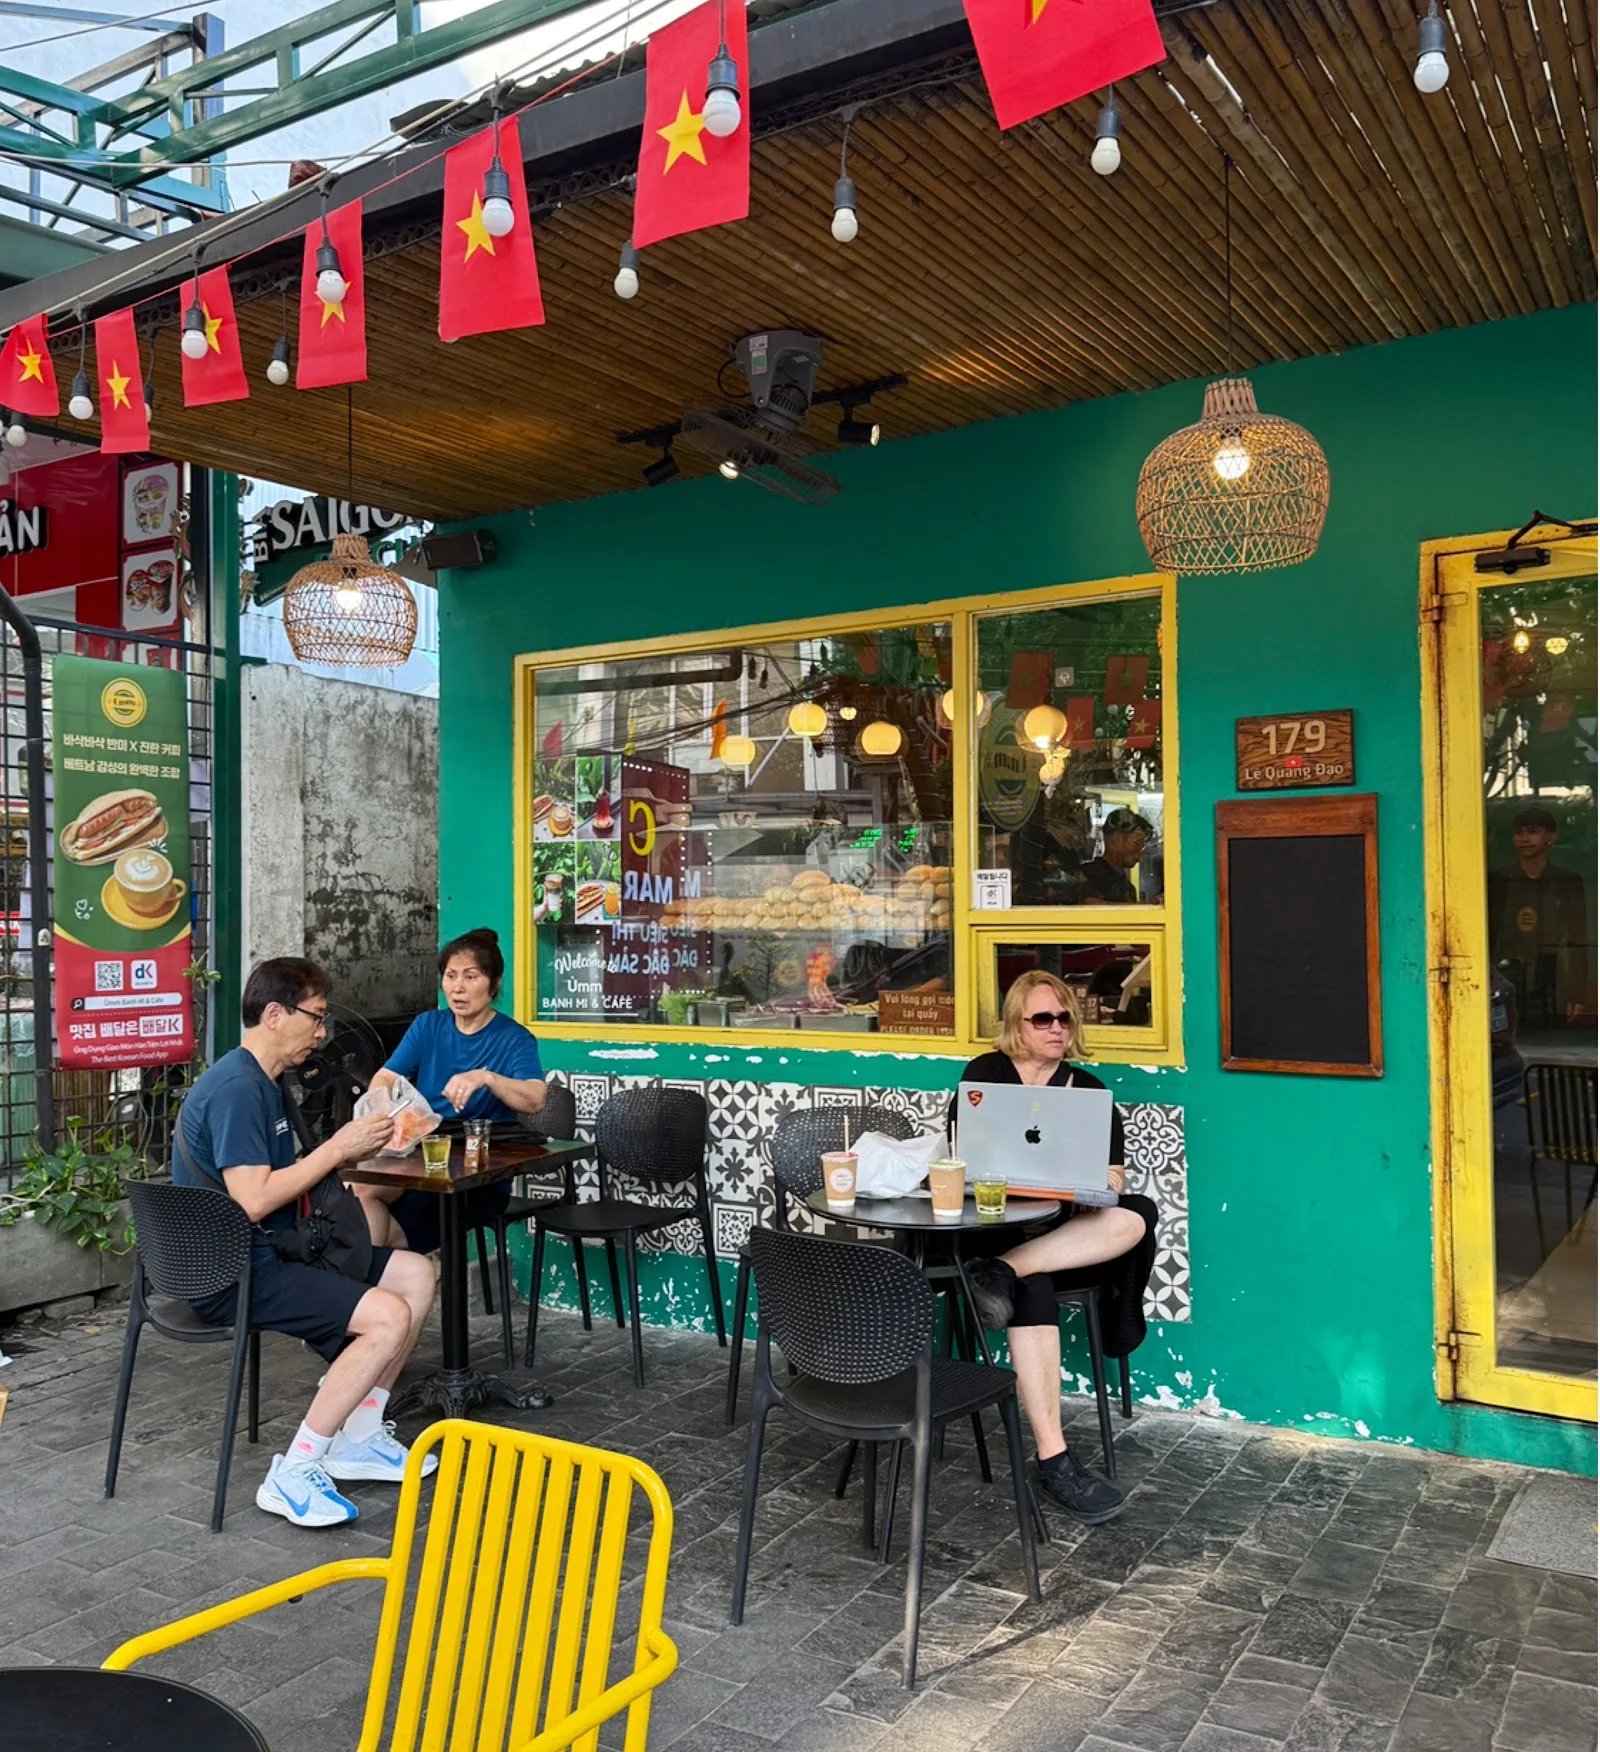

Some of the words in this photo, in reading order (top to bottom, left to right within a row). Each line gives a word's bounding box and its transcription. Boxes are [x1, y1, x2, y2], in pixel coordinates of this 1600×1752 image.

[271, 497, 414, 551] SAIGO
[63, 733, 105, 749] 바삭바삭
[107, 738, 128, 751] 반미
[129, 740, 138, 752] X
[140, 741, 160, 755] 진한
[161, 743, 181, 756] 커피
[1261, 719, 1326, 755] 179
[63, 757, 96, 772] 베트남
[97, 760, 128, 775] 감성의
[129, 763, 159, 778] 완벽한
[161, 766, 181, 779] 조합
[554, 951, 607, 975] Welcome
[542, 997, 573, 1009] BANH
[576, 997, 589, 1008] MI
[591, 998, 599, 1008] &
[885, 994, 899, 1004] Vui
[69, 1023, 97, 1040] 맛집
[99, 1020, 139, 1038] 배달은
